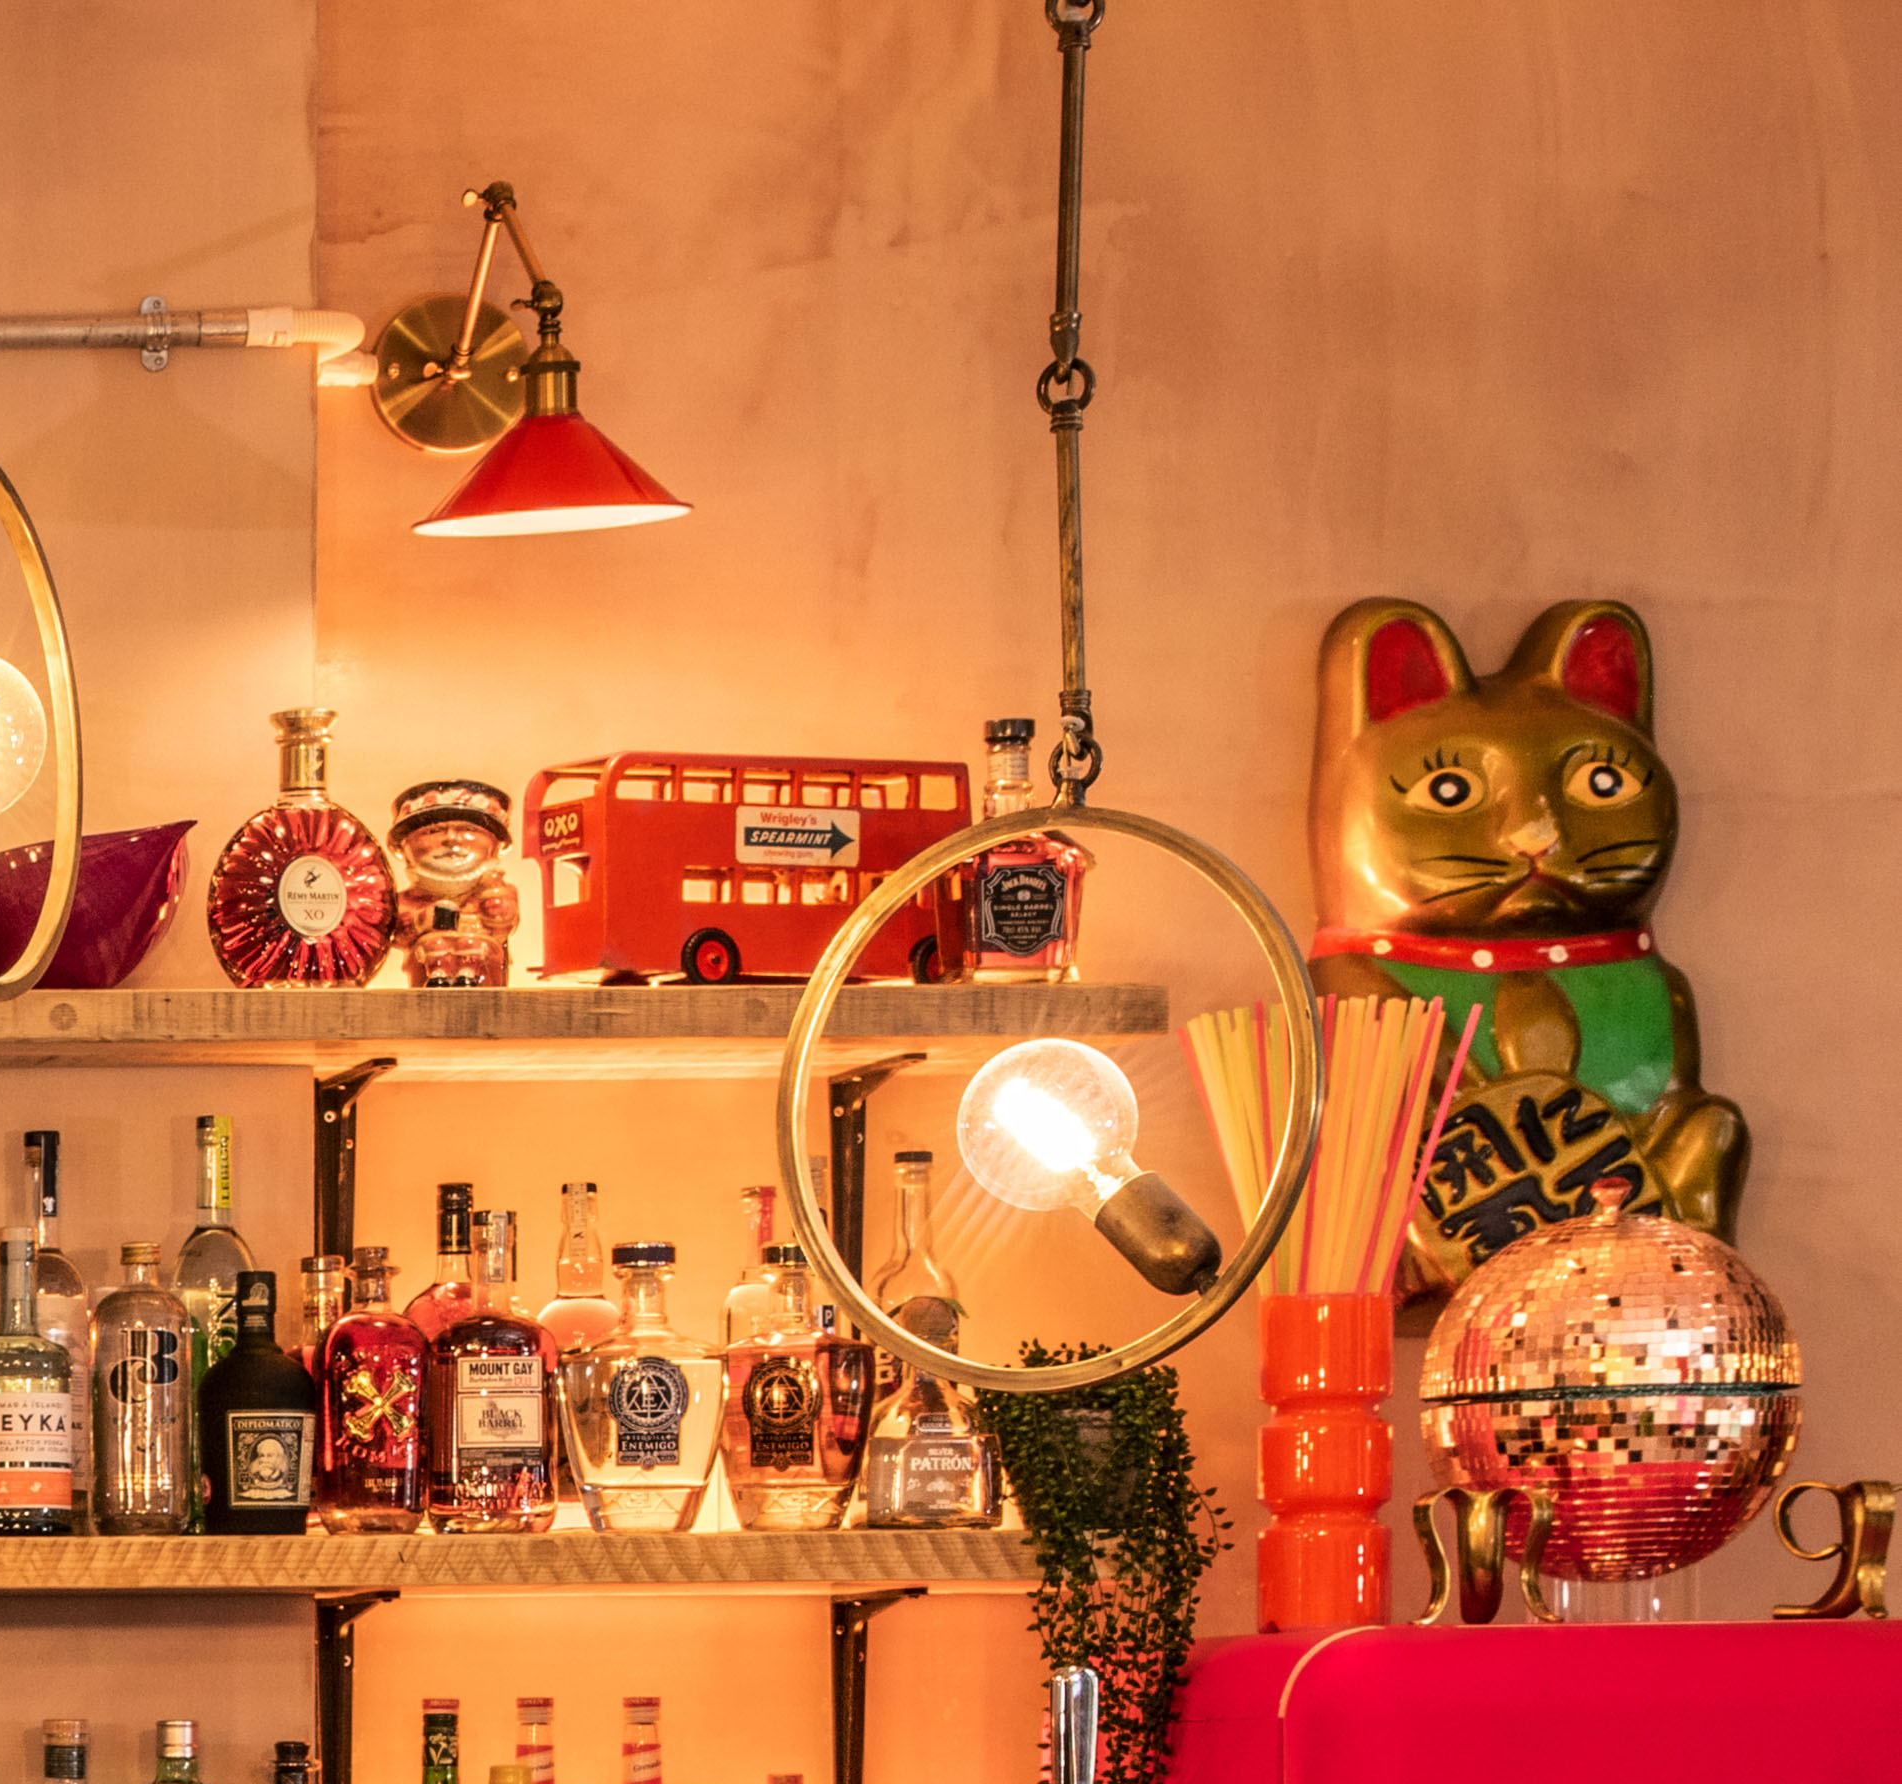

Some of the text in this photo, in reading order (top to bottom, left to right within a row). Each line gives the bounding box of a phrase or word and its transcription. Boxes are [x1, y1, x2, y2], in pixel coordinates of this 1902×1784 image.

[543, 811, 578, 838] OXO
[759, 811, 817, 828] Wrigley's
[748, 831, 832, 847] SPEARMINT
[310, 891, 340, 901] MARTIN
[303, 908, 326, 921] XO
[468, 1363, 535, 1379] MOUNT GAY
[481, 1408, 524, 1421] BLACK
[477, 1420, 527, 1432] BARREL
[621, 1441, 677, 1452] ENEMIGO
[755, 1441, 811, 1452] ENEMIGO
[910, 1450, 973, 1471] PATRÓN
